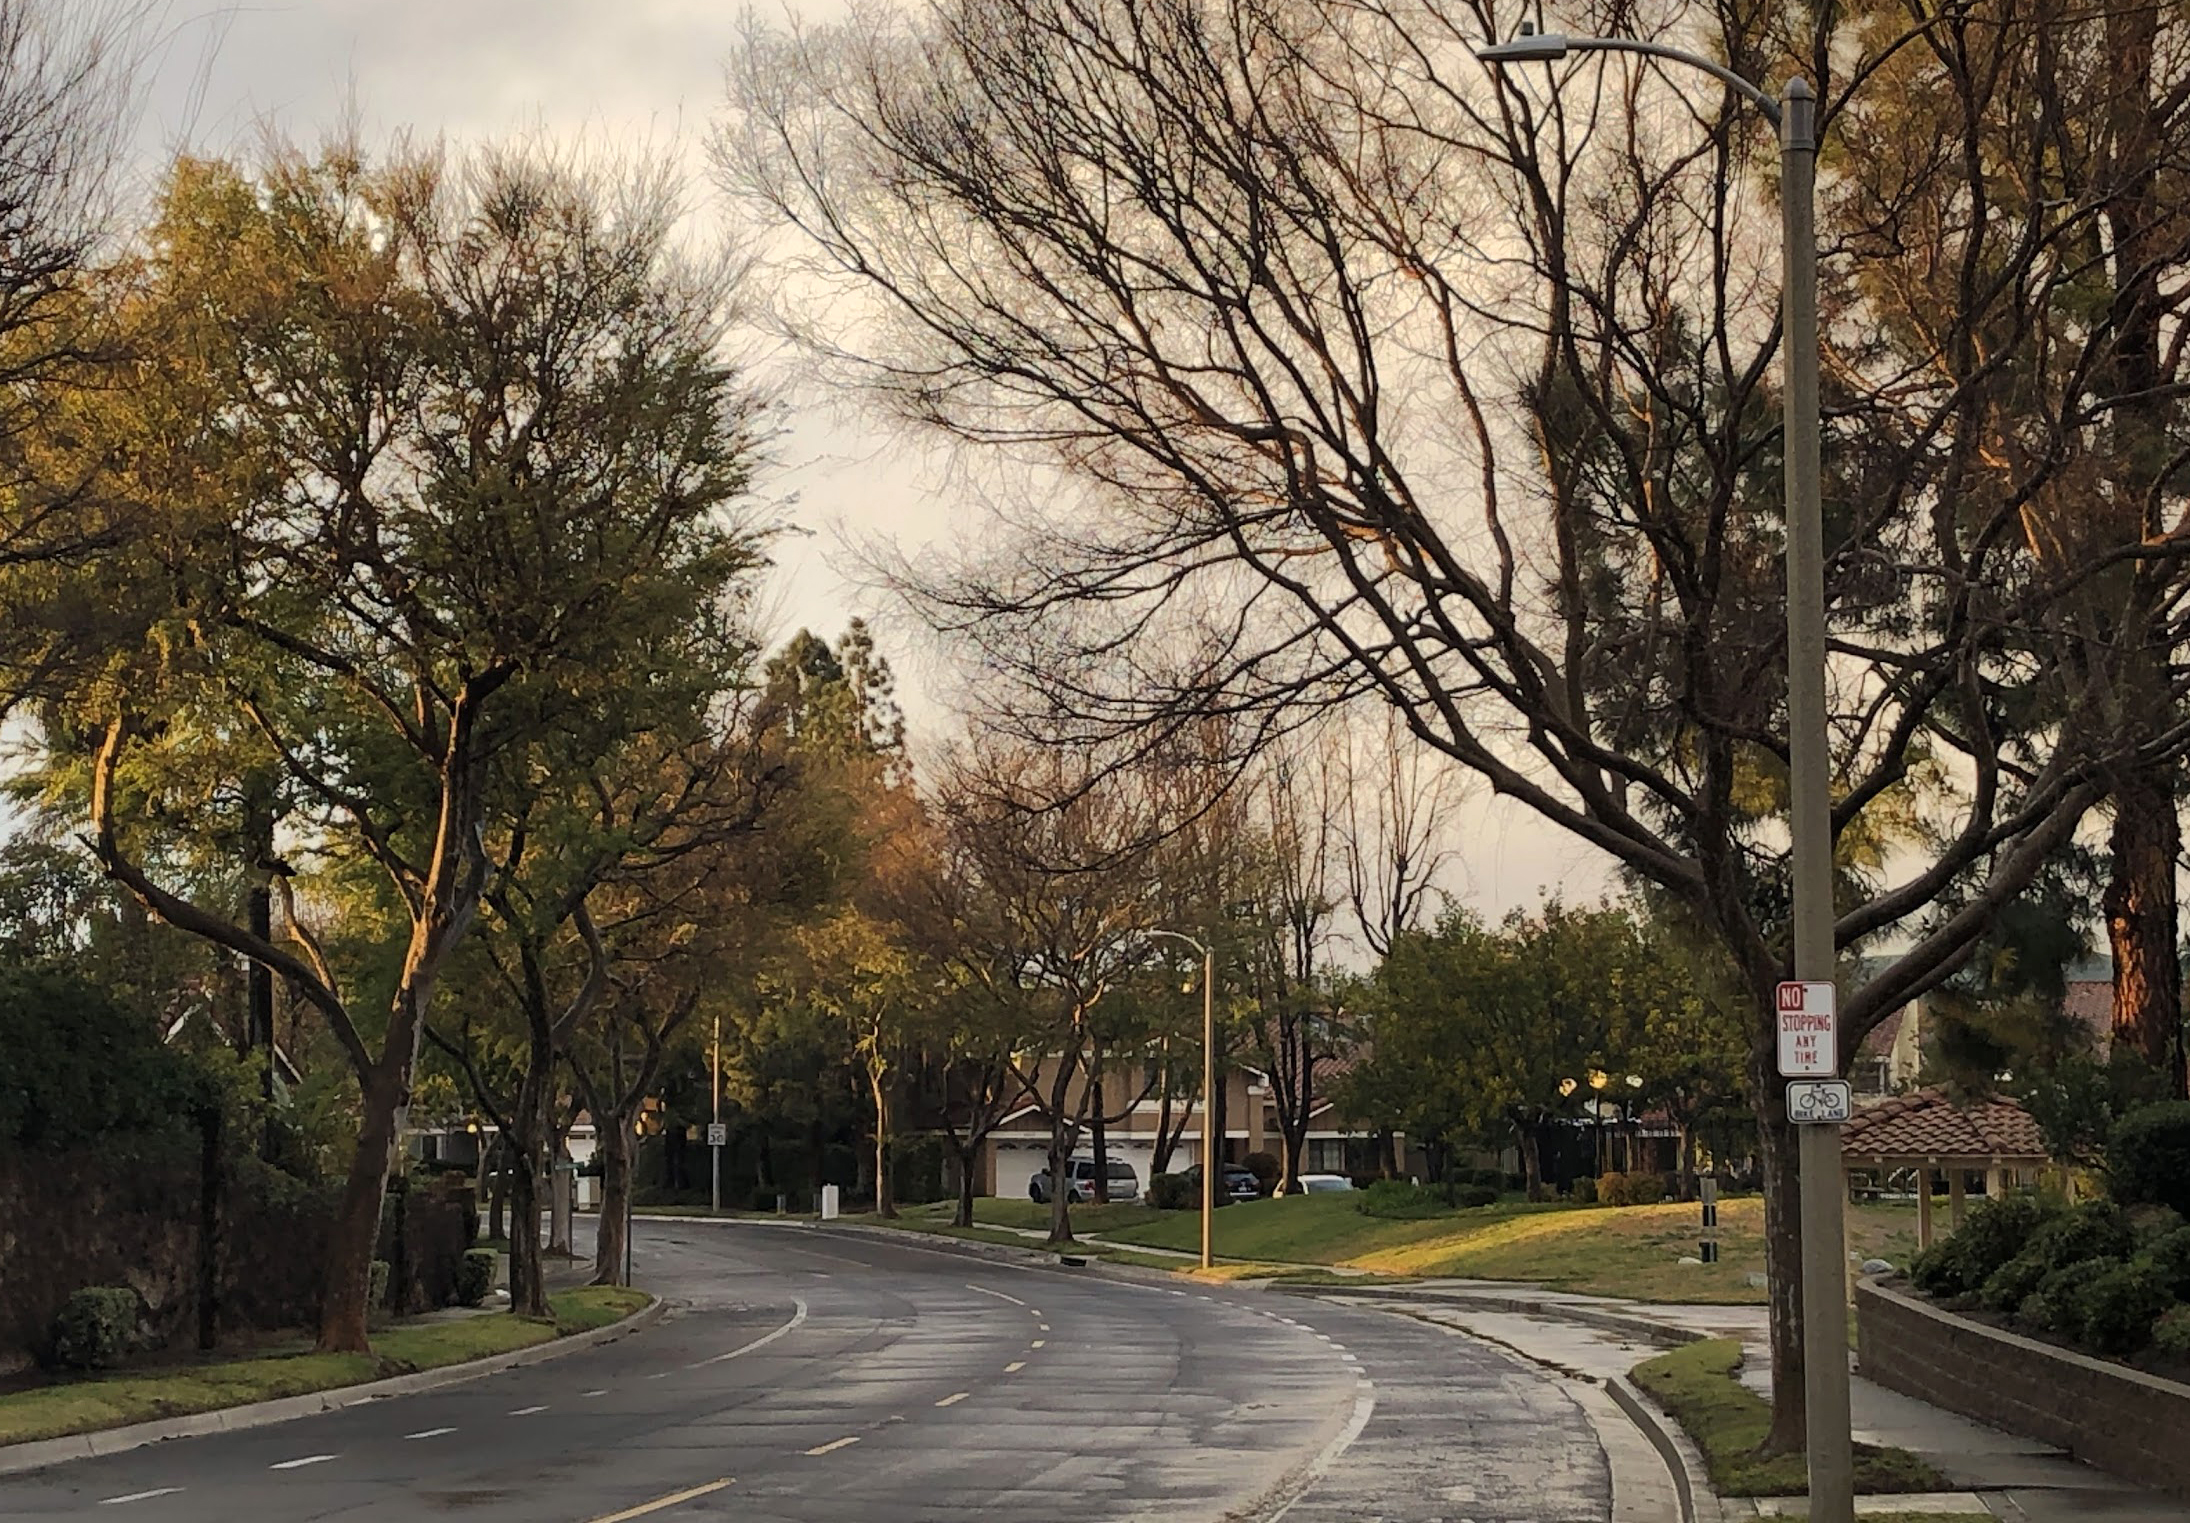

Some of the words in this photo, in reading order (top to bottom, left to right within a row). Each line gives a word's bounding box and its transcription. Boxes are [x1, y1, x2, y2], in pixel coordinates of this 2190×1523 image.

[1781, 986, 1801, 1008] NO
[1782, 1014, 1831, 1032] STOPPING
[1795, 1035, 1817, 1048] ANY
[1794, 1050, 1818, 1064] TIME
[1822, 1109, 1844, 1119] LANE
